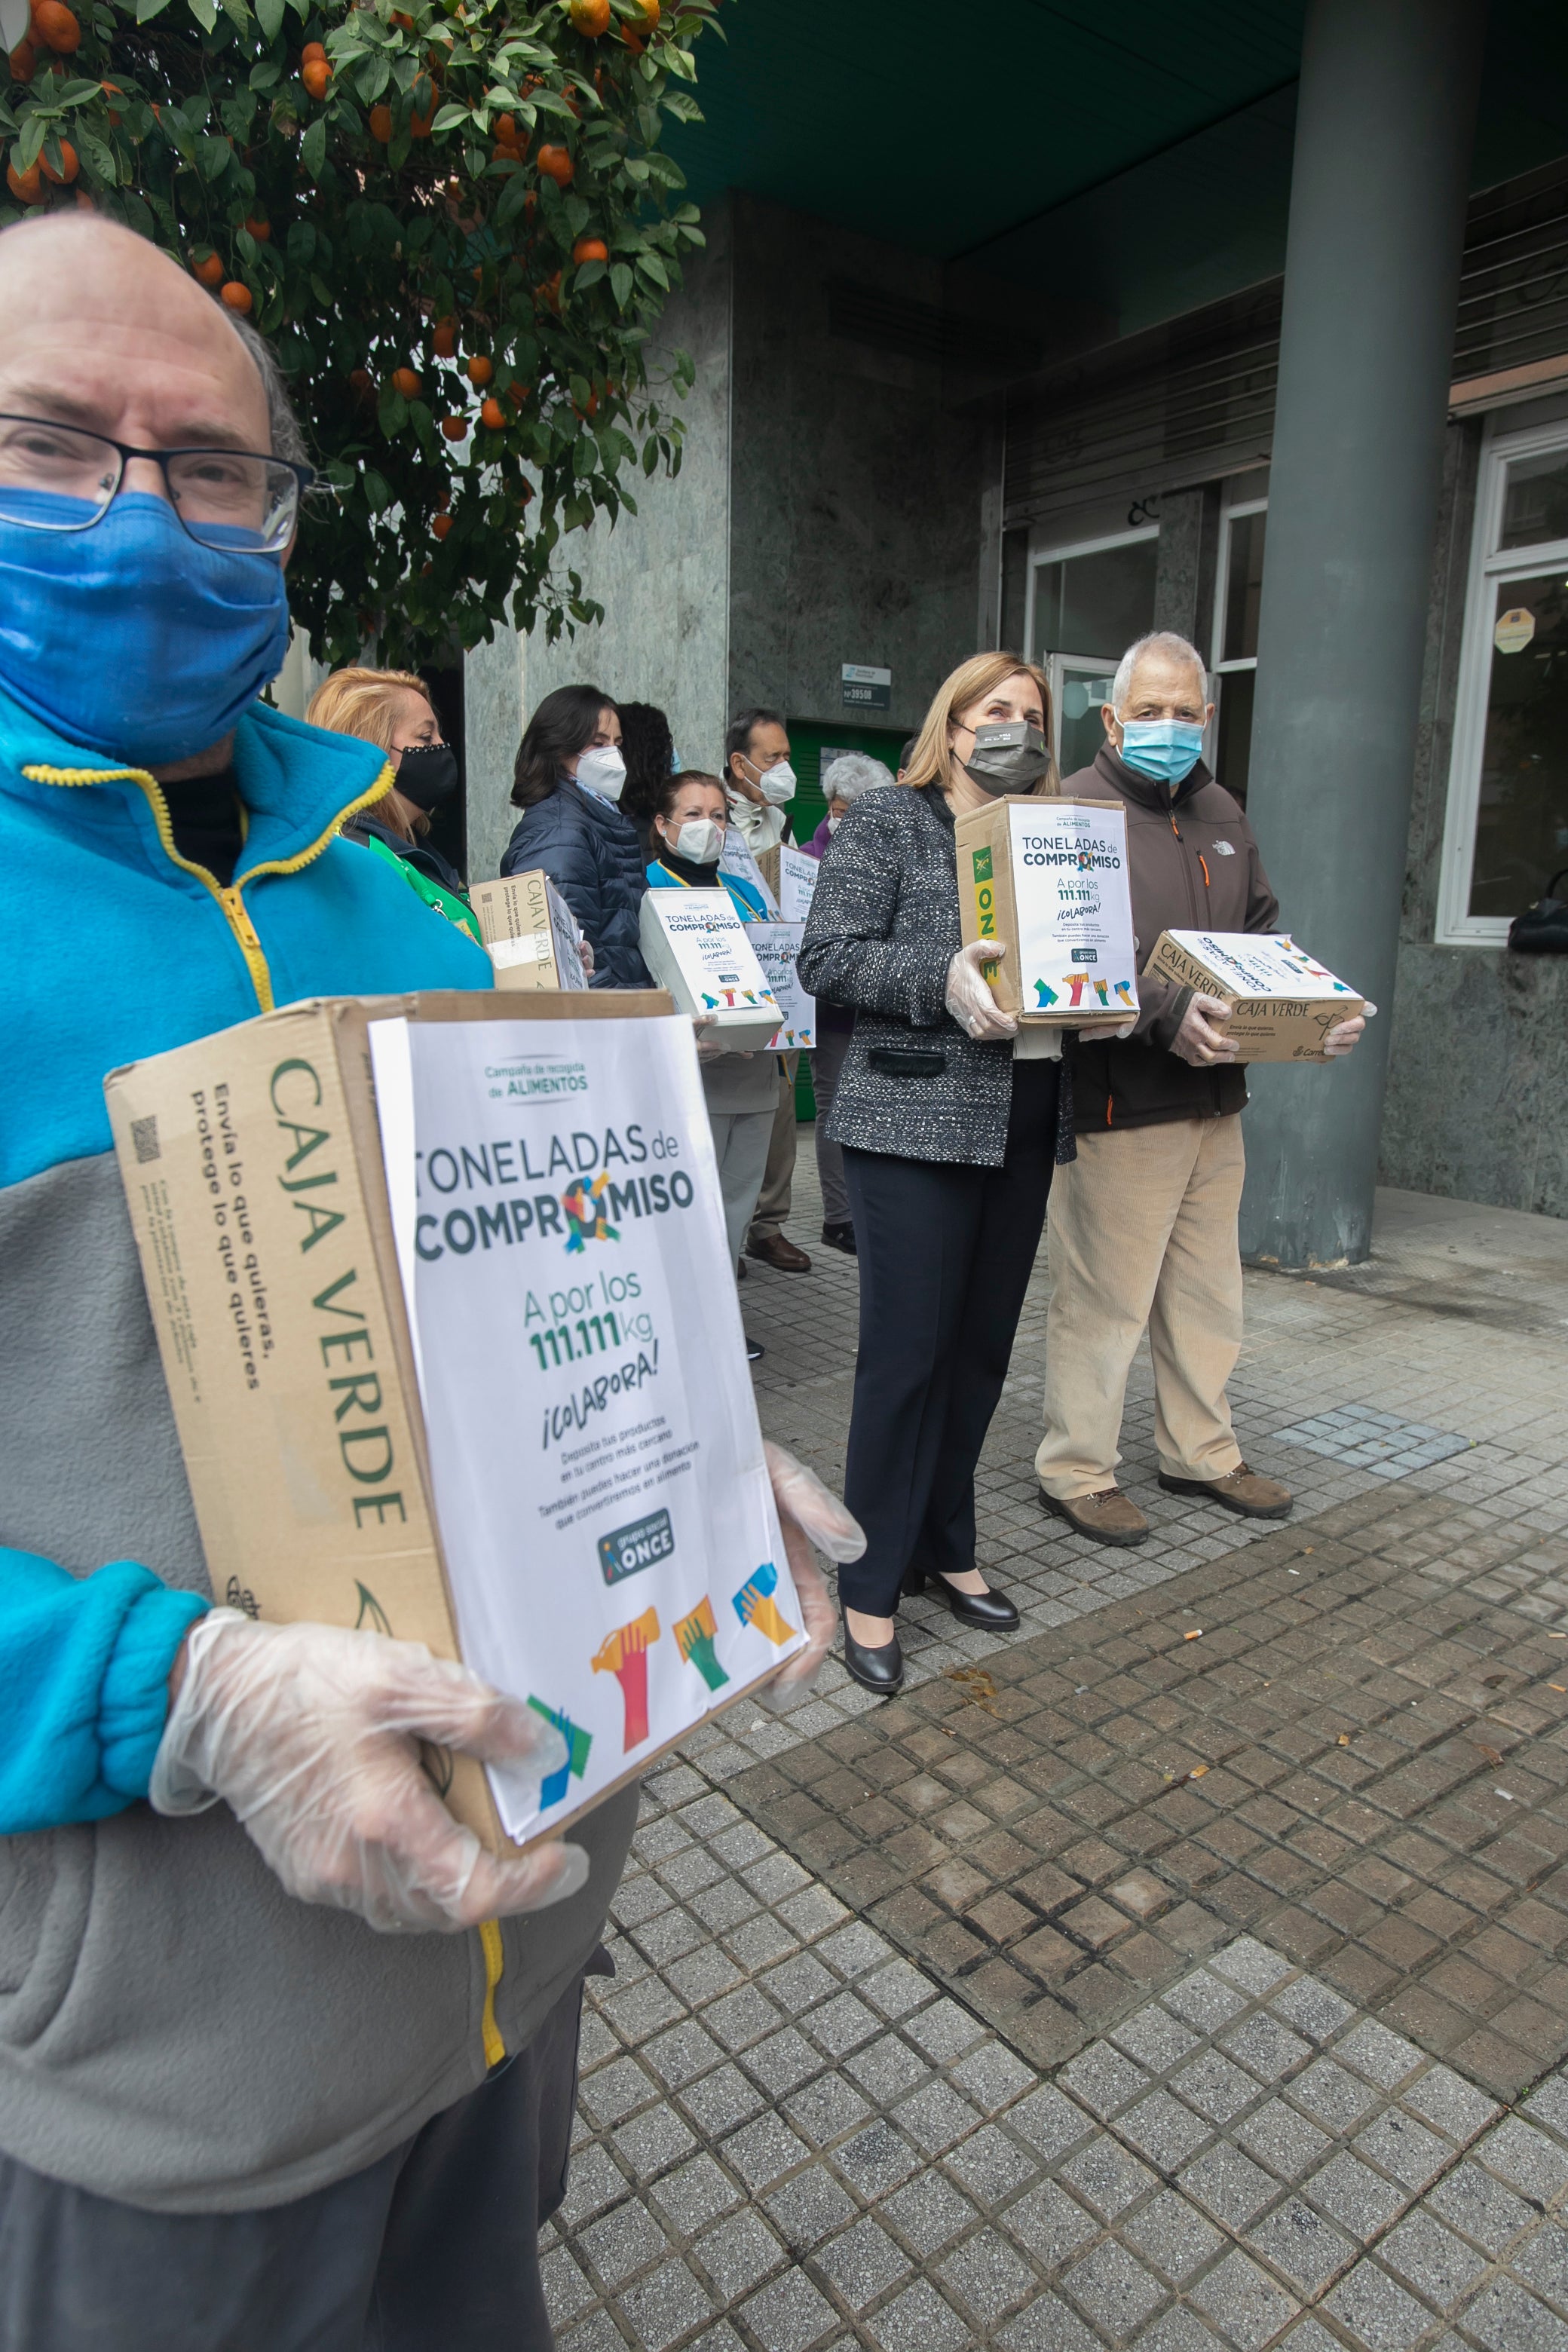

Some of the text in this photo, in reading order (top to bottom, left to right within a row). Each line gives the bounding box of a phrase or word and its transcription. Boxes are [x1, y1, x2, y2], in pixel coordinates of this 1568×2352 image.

[1022, 837, 1117, 853] TONELADAS de
[1024, 852, 1120, 871] COMPROMISO
[786, 861, 816, 878] TONELAD
[786, 868, 815, 887] COMPRO
[1057, 877, 1098, 890] A por los
[528, 879, 544, 917] CAJA
[665, 914, 726, 923] TONELADAS
[669, 921, 740, 933] COMPROMISO
[979, 888, 997, 979] ONE
[757, 951, 798, 965] OMPROM
[1161, 943, 1187, 973] CAJA
[1203, 937, 1272, 992] COMPROMISO
[1236, 1003, 1310, 1018] CAJA VERDE
[484, 1063, 585, 1079] Campaña de recogida
[488, 1075, 588, 1099] de ALIMENTOS
[270, 1058, 347, 1254] CAJA
[651, 1131, 680, 1159] de
[215, 1082, 274, 1359] Envía lo que quieras,
[415, 1170, 694, 1261] COMPROMISO
[191, 1090, 259, 1390] protege lo que quieres
[525, 1270, 642, 1328] A por los
[312, 1266, 409, 1530] VERDE
[542, 1337, 659, 1450] ¡COLABORA!
[560, 1429, 672, 1484] en tu centro más cercano
[561, 1416, 666, 1465] Deposita tus productos
[538, 1441, 700, 1518] También puedes hacer una donación
[555, 1461, 692, 1530] que convertiremos en alimento
[617, 1515, 667, 1551] grupo social
[621, 1530, 672, 1570] ONCE
